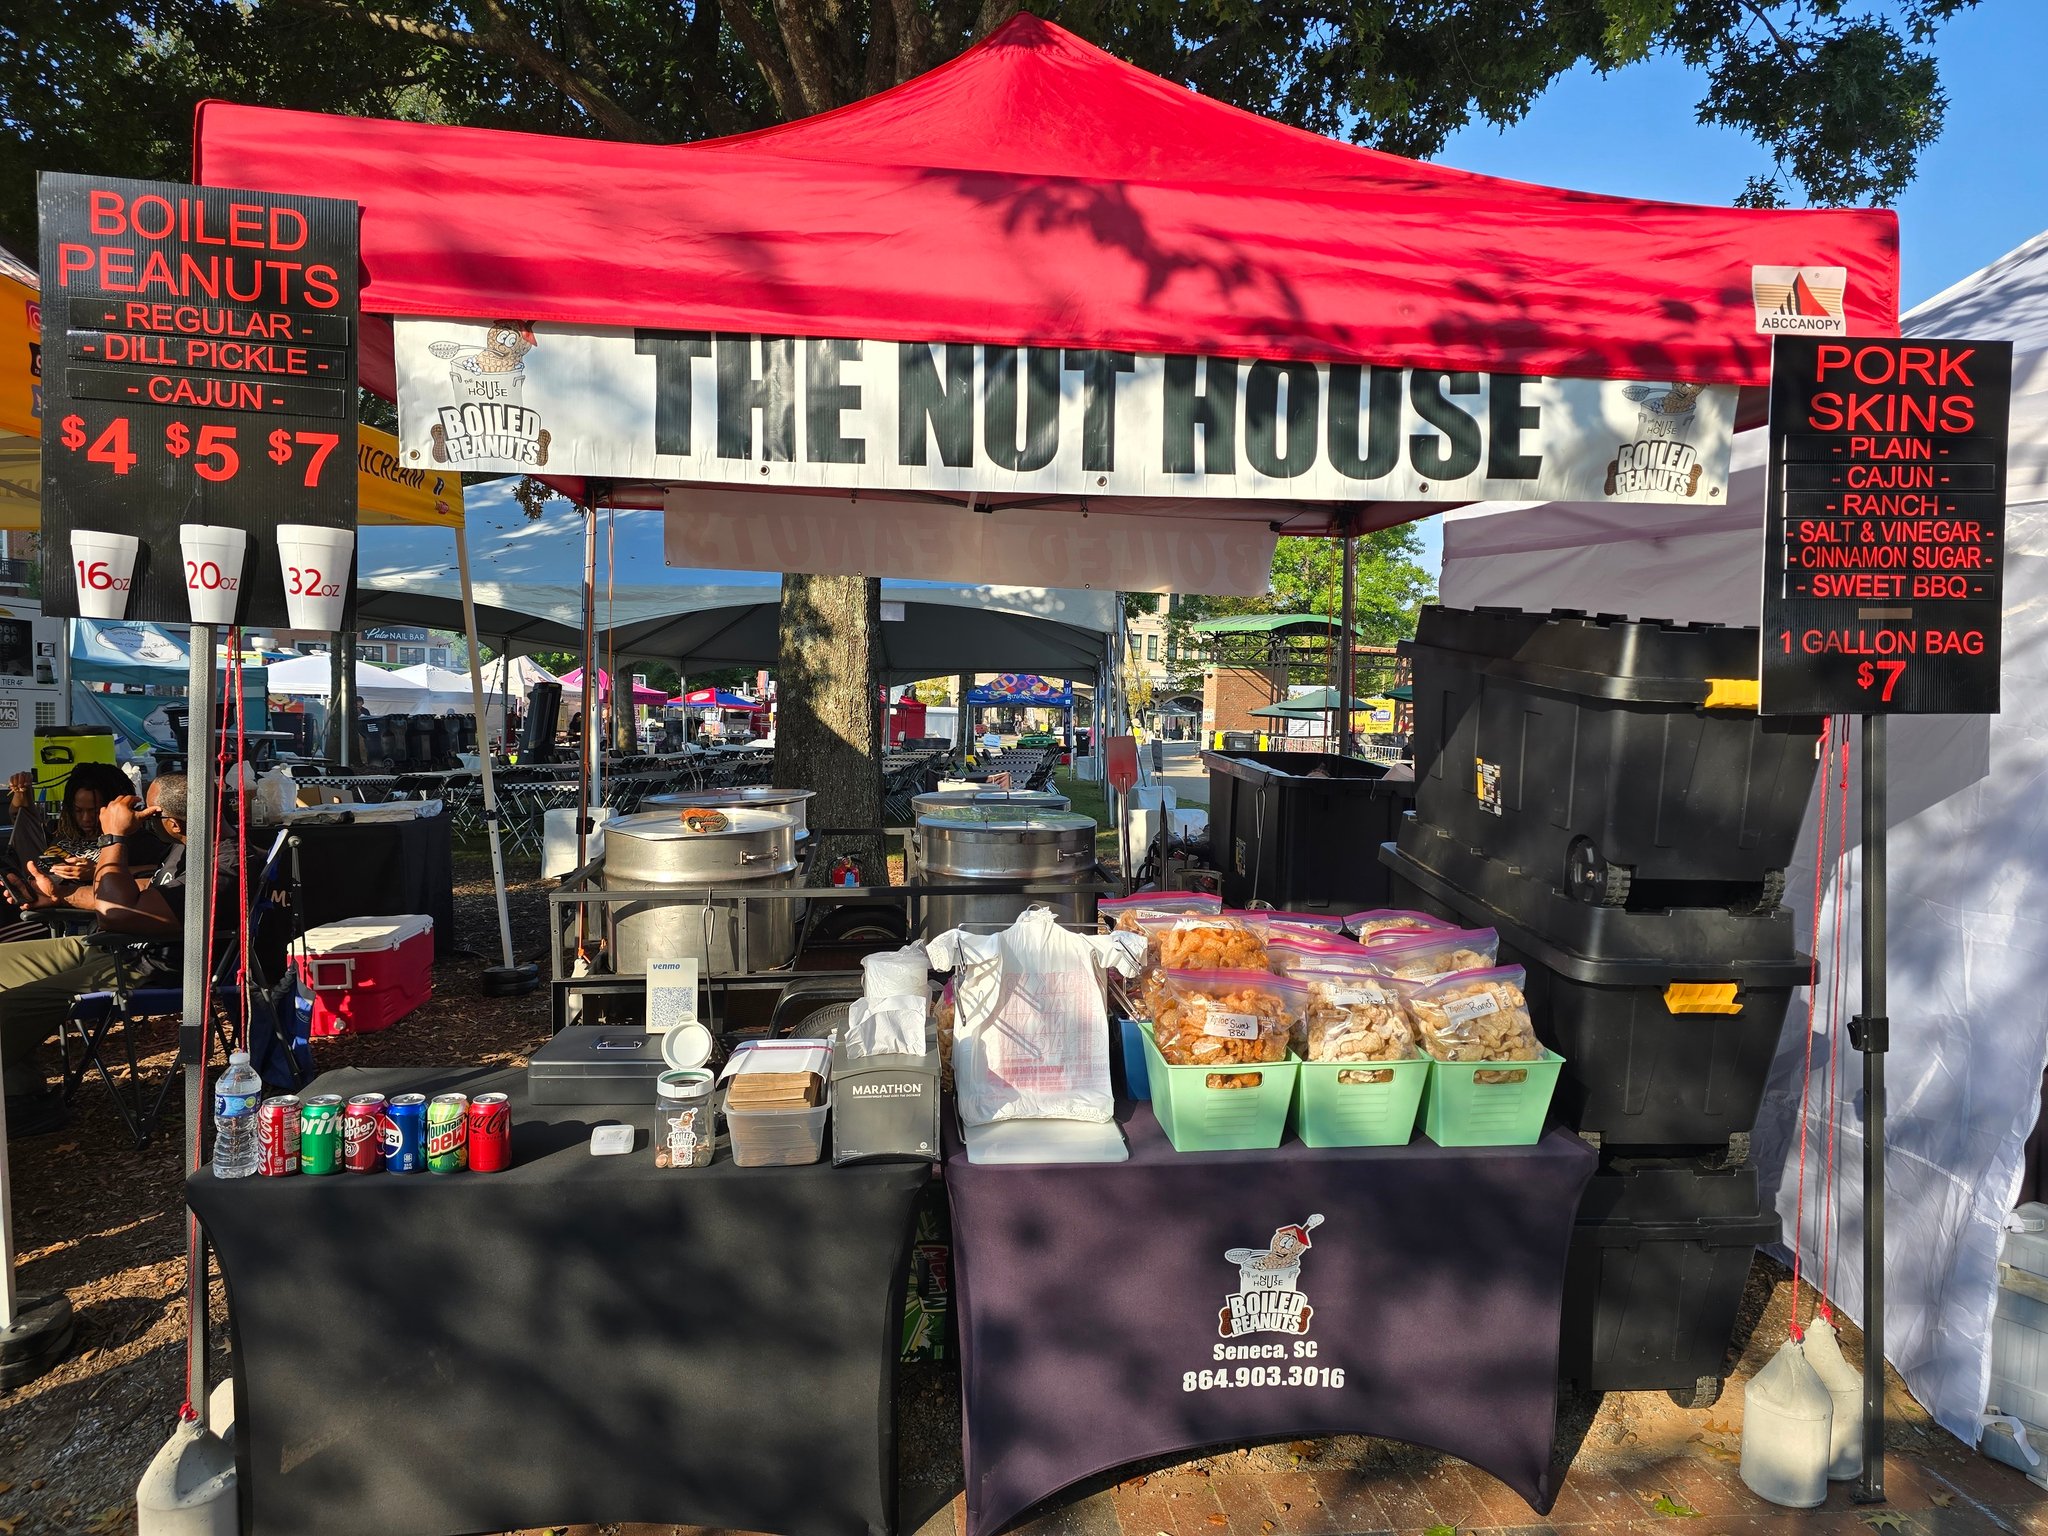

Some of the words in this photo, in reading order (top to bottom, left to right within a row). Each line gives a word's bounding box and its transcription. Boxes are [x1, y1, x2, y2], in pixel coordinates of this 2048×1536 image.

[90, 190, 309, 252] BOILED
[58, 242, 340, 309] PEANUTS
[126, 302, 293, 340] REGULAR
[1761, 317, 1841, 331] ABCCANOPY
[105, 335, 177, 366] DILL
[187, 342, 308, 375] PICKLE
[1816, 345, 1976, 388] PORK
[148, 375, 263, 410] CAJUN
[635, 328, 866, 465] THE
[898, 340, 1136, 474] NUT
[1162, 353, 1543, 481] HOUSE
[437, 402, 541, 442] BOILED
[1808, 391, 1976, 434] SKINS
[61, 414, 137, 476] $4
[165, 421, 240, 483] $5
[267, 428, 340, 488] $7
[445, 435, 541, 466] PEANUTS
[1618, 440, 1697, 475] BOILED
[1850, 437, 1932, 461] PLAIN
[1615, 469, 1691, 497] PEANUTS
[1847, 465, 1934, 490] CAJUN
[1843, 494, 1940, 517] RANCH
[1799, 520, 1855, 543] SALT
[1860, 521, 1875, 544] &
[1880, 521, 1981, 544] VINEGAR
[1801, 546, 1907, 569] CINNAMON
[1912, 546, 1982, 569] SUGAR
[1812, 574, 1907, 598] SWEET
[1913, 575, 1968, 600] BBQ
[389, 632, 408, 640] NAIL
[409, 633, 425, 641] BAR
[1780, 631, 1791, 654] 1
[1802, 630, 1917, 655] GALLON
[1925, 630, 1985, 655] BAG
[2, 678, 16, 686] TIER
[1857, 660, 1906, 703] $7
[1467, 998, 1495, 1014] Ranch
[852, 1083, 922, 1096] MARATHON
[1229, 1291, 1307, 1317] BOILED
[1230, 1312, 1303, 1335] PEANUTS
[1213, 1342, 1288, 1361] Seneca,
[1293, 1341, 1318, 1359] SC
[1182, 1366, 1346, 1393] 864.903.3016
